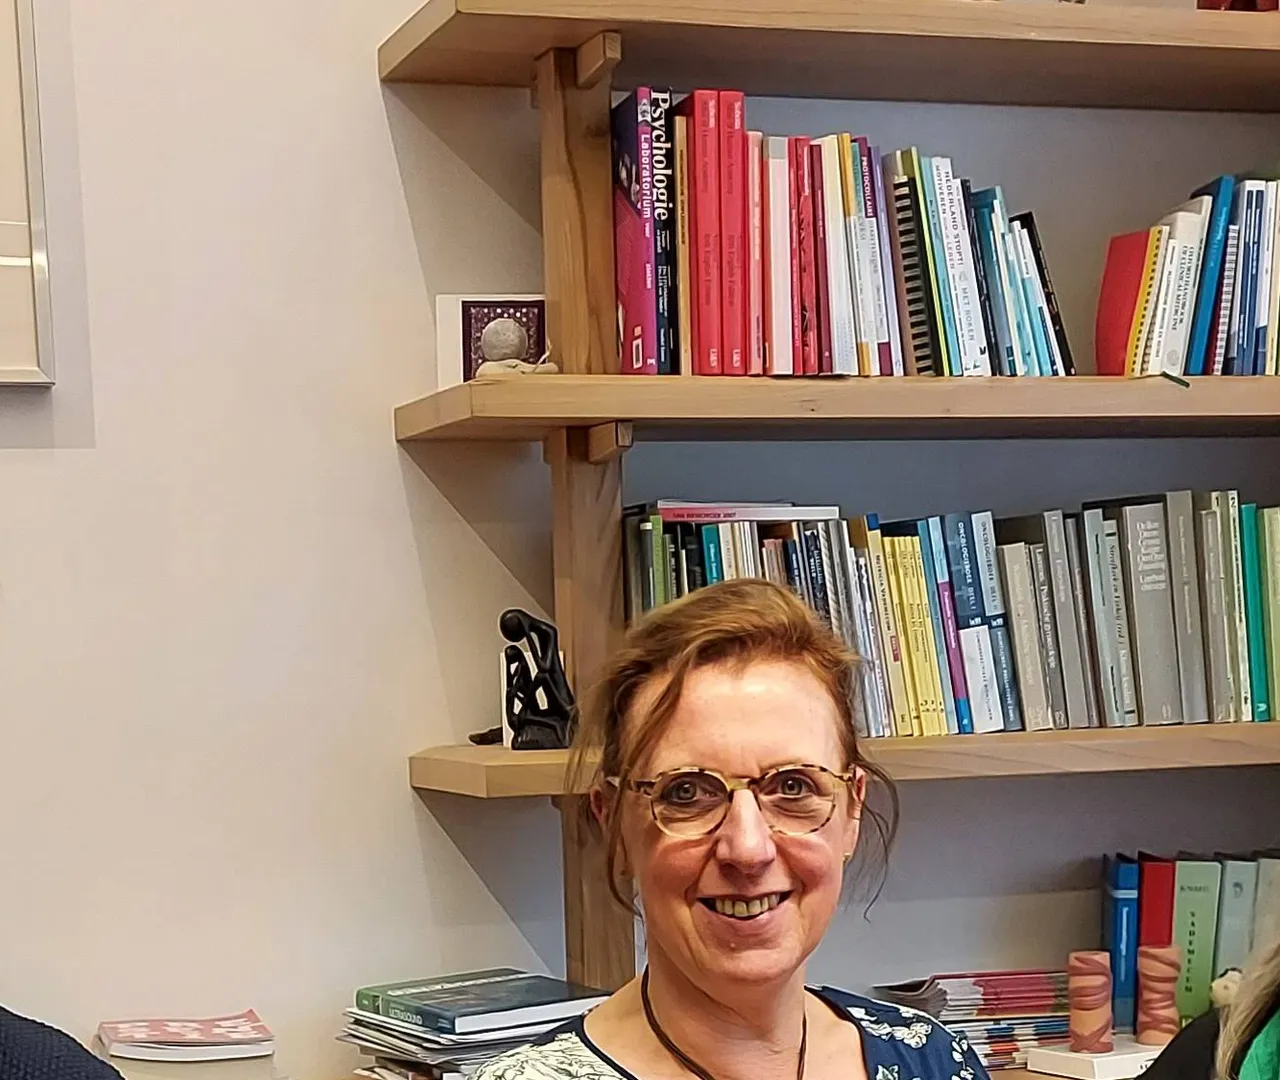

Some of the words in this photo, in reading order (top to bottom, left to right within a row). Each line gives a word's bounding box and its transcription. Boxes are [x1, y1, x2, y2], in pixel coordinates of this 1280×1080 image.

[641, 134, 652, 218] Laboratorium
[651, 90, 672, 220] Psychologie
[861, 156, 873, 217] PROTOCOLLAIRE
[944, 171, 959, 230] NEDERLAND
[952, 233, 964, 265] STOPT!
